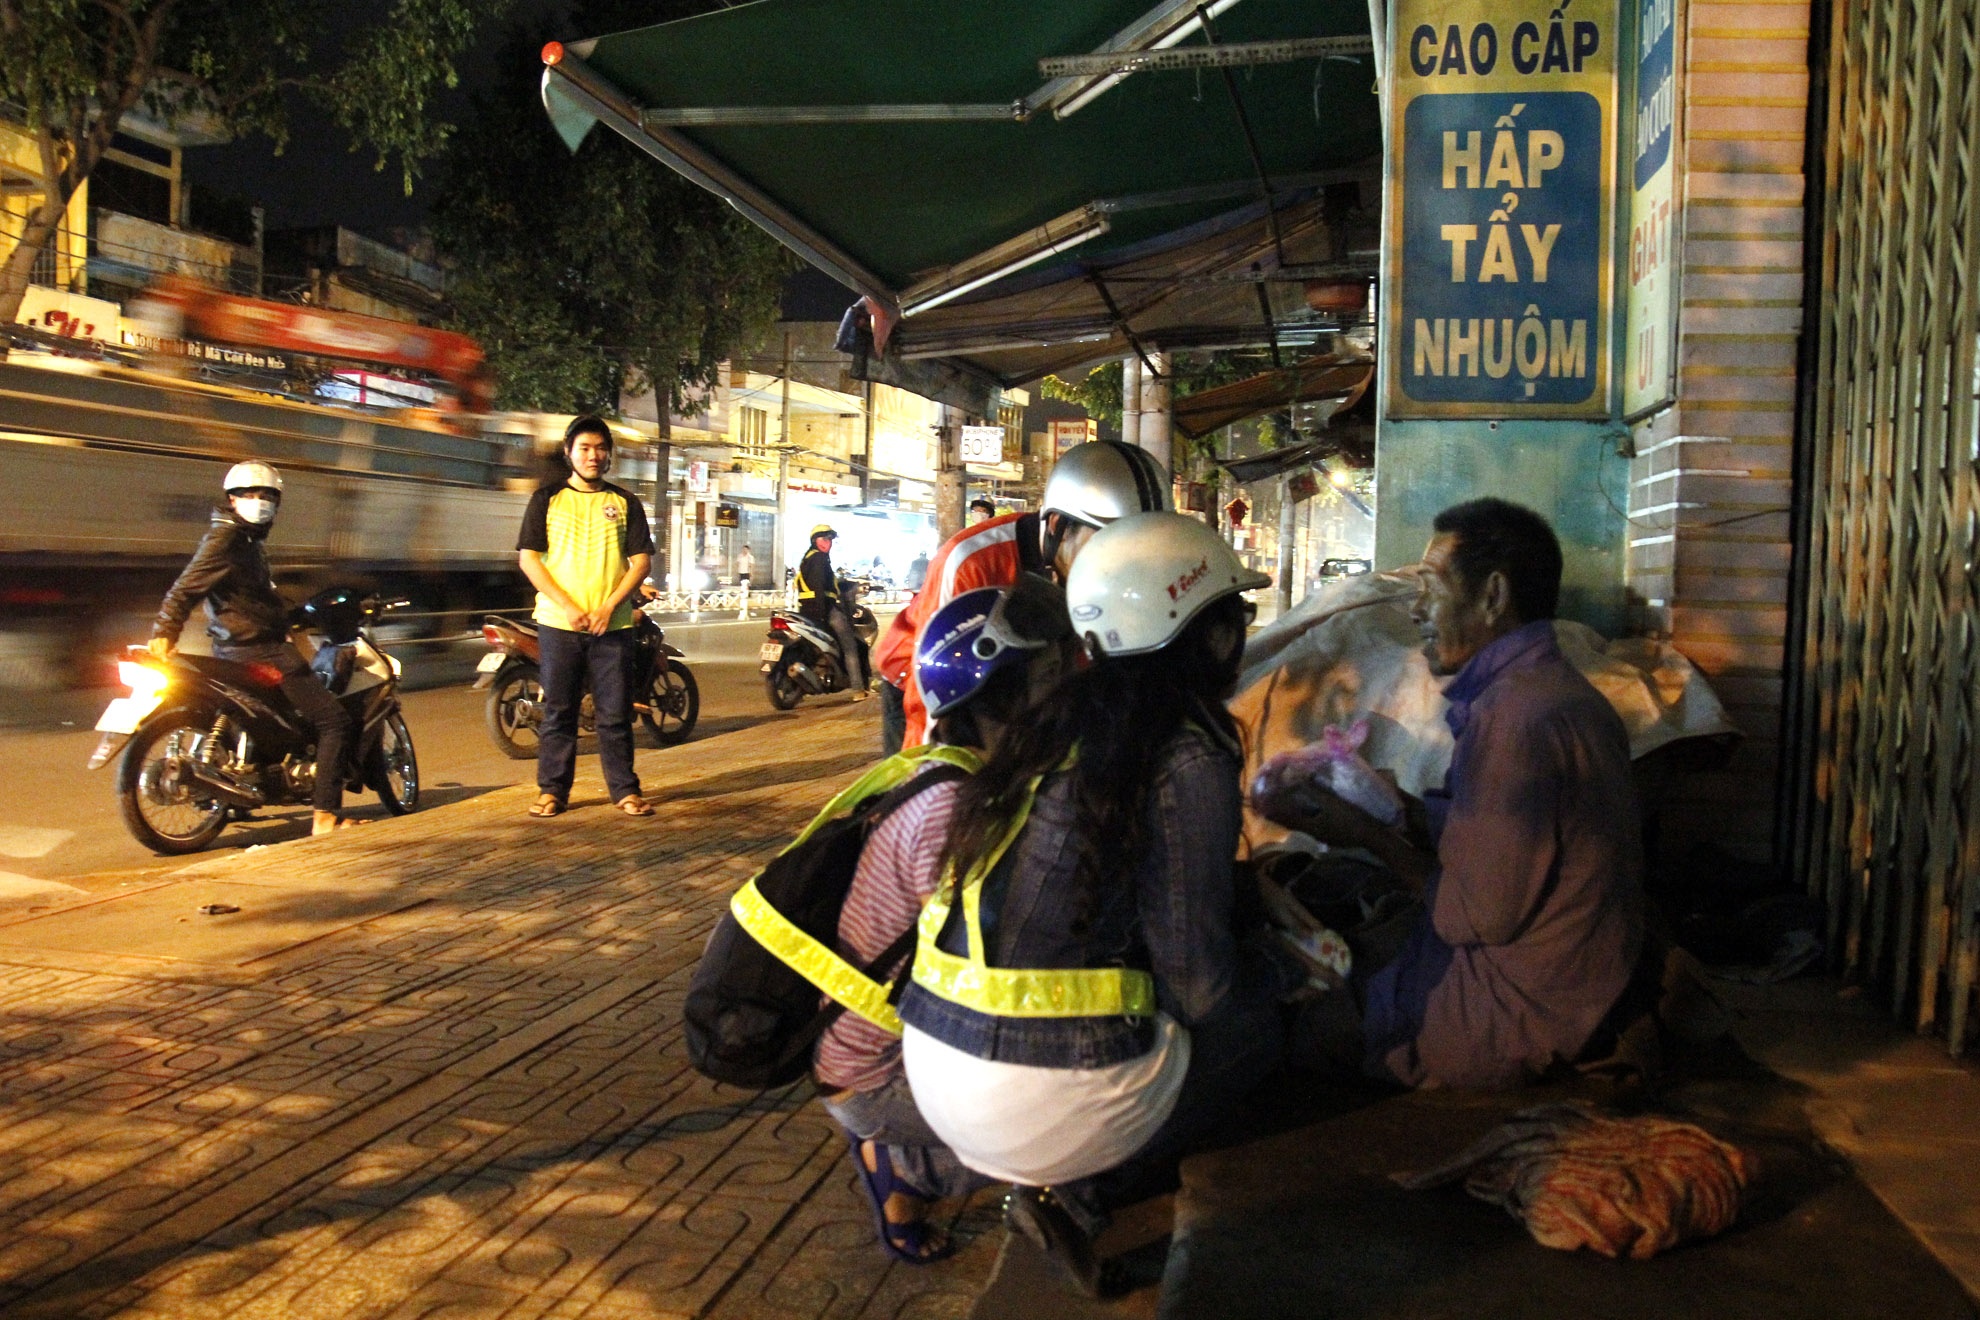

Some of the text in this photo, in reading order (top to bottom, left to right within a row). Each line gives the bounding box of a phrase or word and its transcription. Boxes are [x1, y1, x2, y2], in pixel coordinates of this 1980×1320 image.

[1410, 0, 1599, 77] CAO CẤP
[1442, 103, 1565, 189] HẤP
[1440, 192, 1562, 283] TẨY
[1413, 303, 1587, 397] NHUỘM
